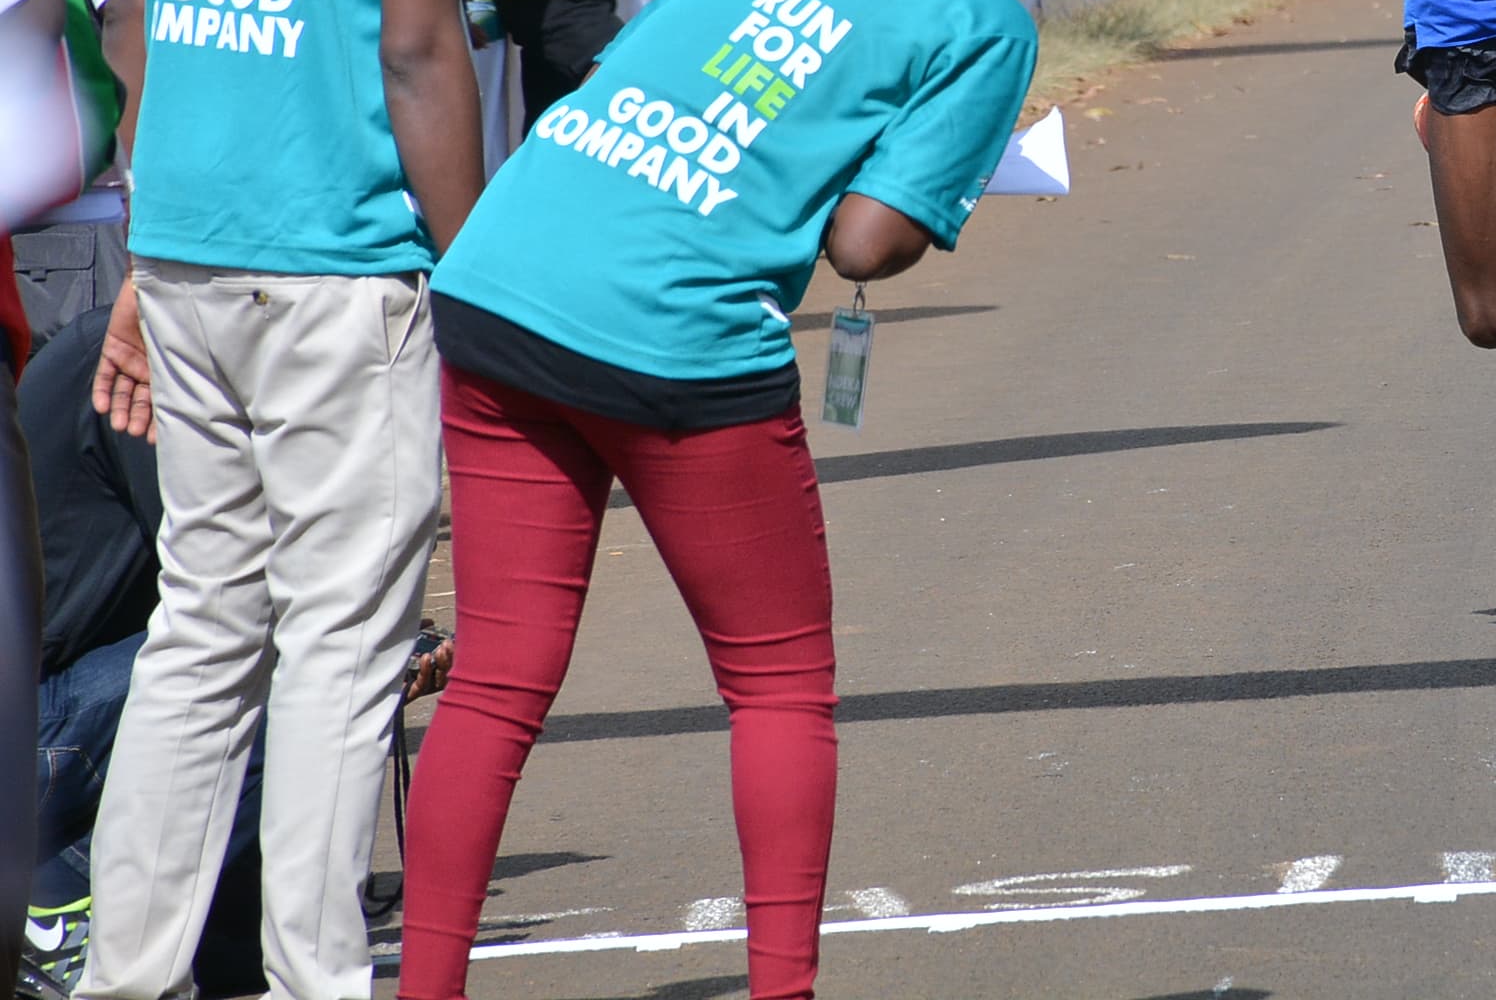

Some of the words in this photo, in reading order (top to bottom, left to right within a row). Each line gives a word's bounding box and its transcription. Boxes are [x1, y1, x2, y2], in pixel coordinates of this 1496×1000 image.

[151, 0, 304, 58] MPANY
[729, 10, 823, 90] FOR
[701, 43, 796, 121] LIFE
[702, 91, 767, 149] IN
[535, 104, 739, 217] COMPANY
[608, 86, 741, 175] GOOD
